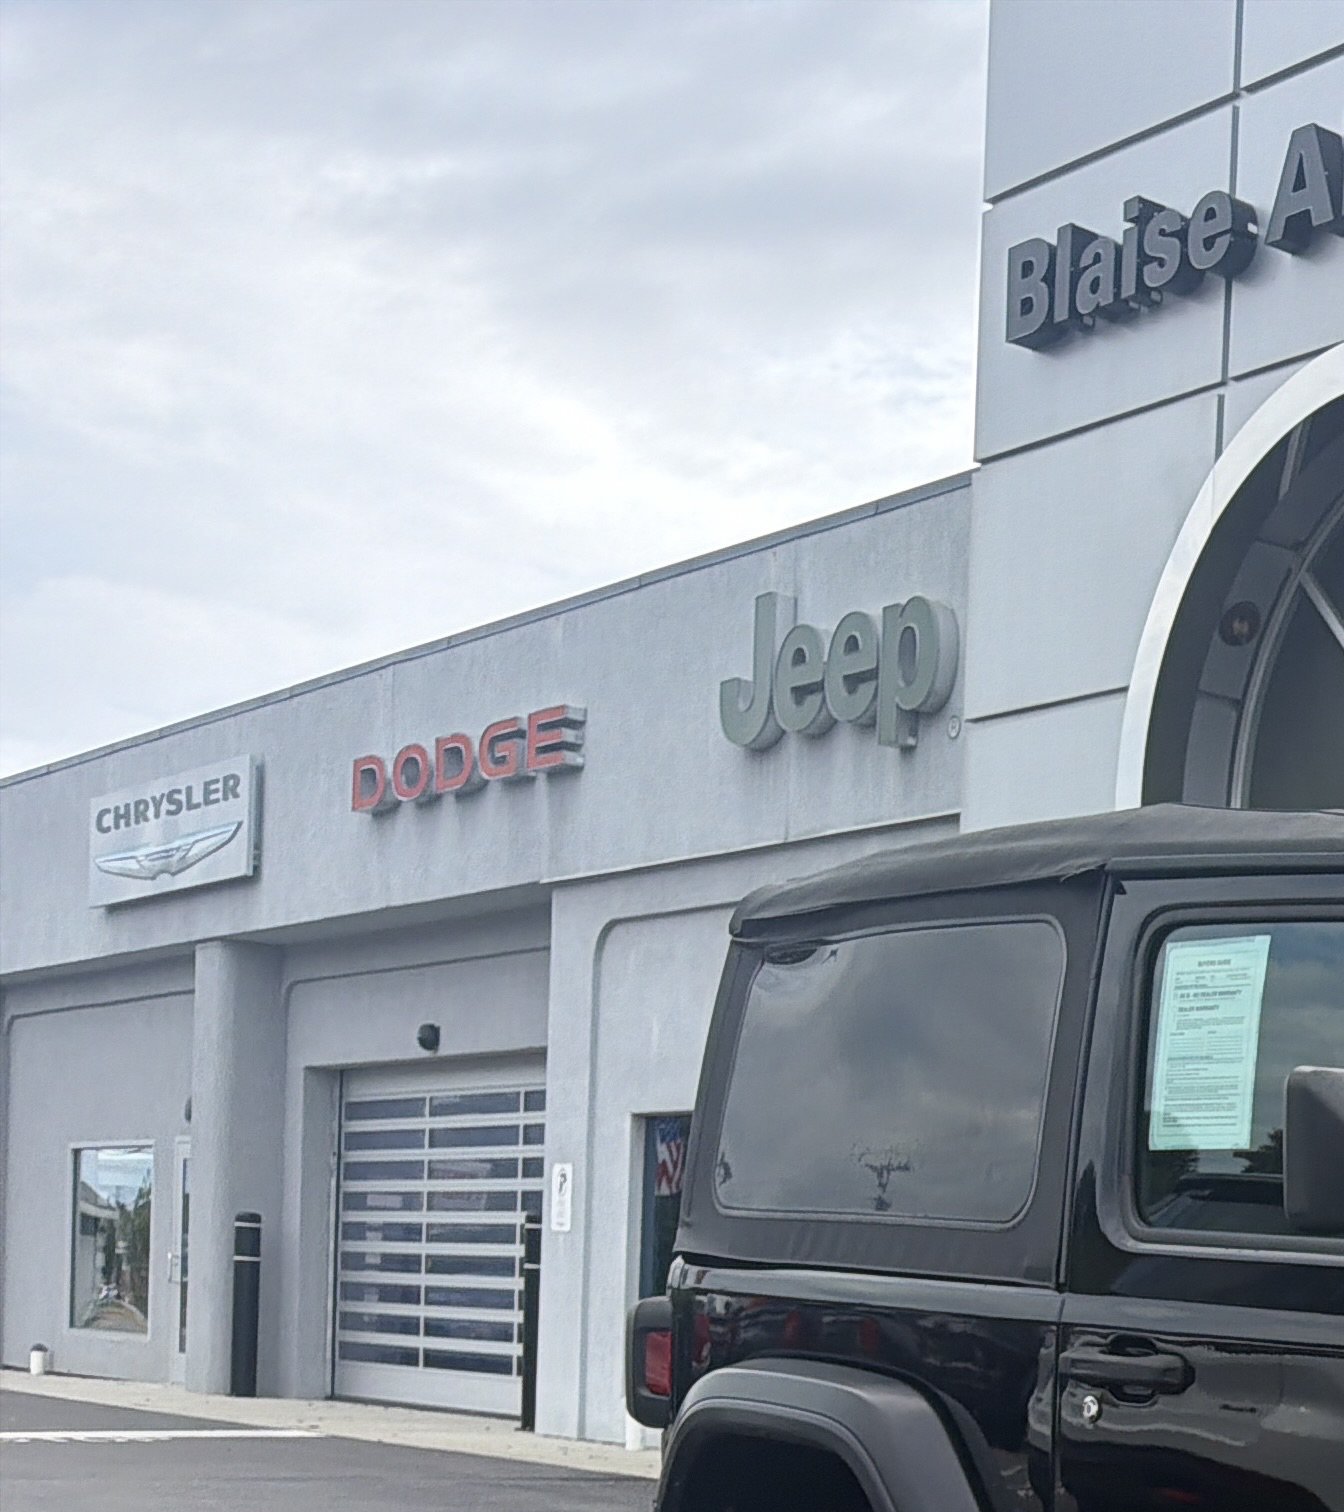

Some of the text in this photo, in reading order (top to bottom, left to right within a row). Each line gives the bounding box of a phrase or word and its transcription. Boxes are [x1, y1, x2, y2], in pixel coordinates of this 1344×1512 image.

[1006, 190, 1247, 348] Blaise
[719, 591, 958, 750] Jeep
[95, 772, 242, 834] CHRYSLER
[351, 703, 587, 813] DODGE
